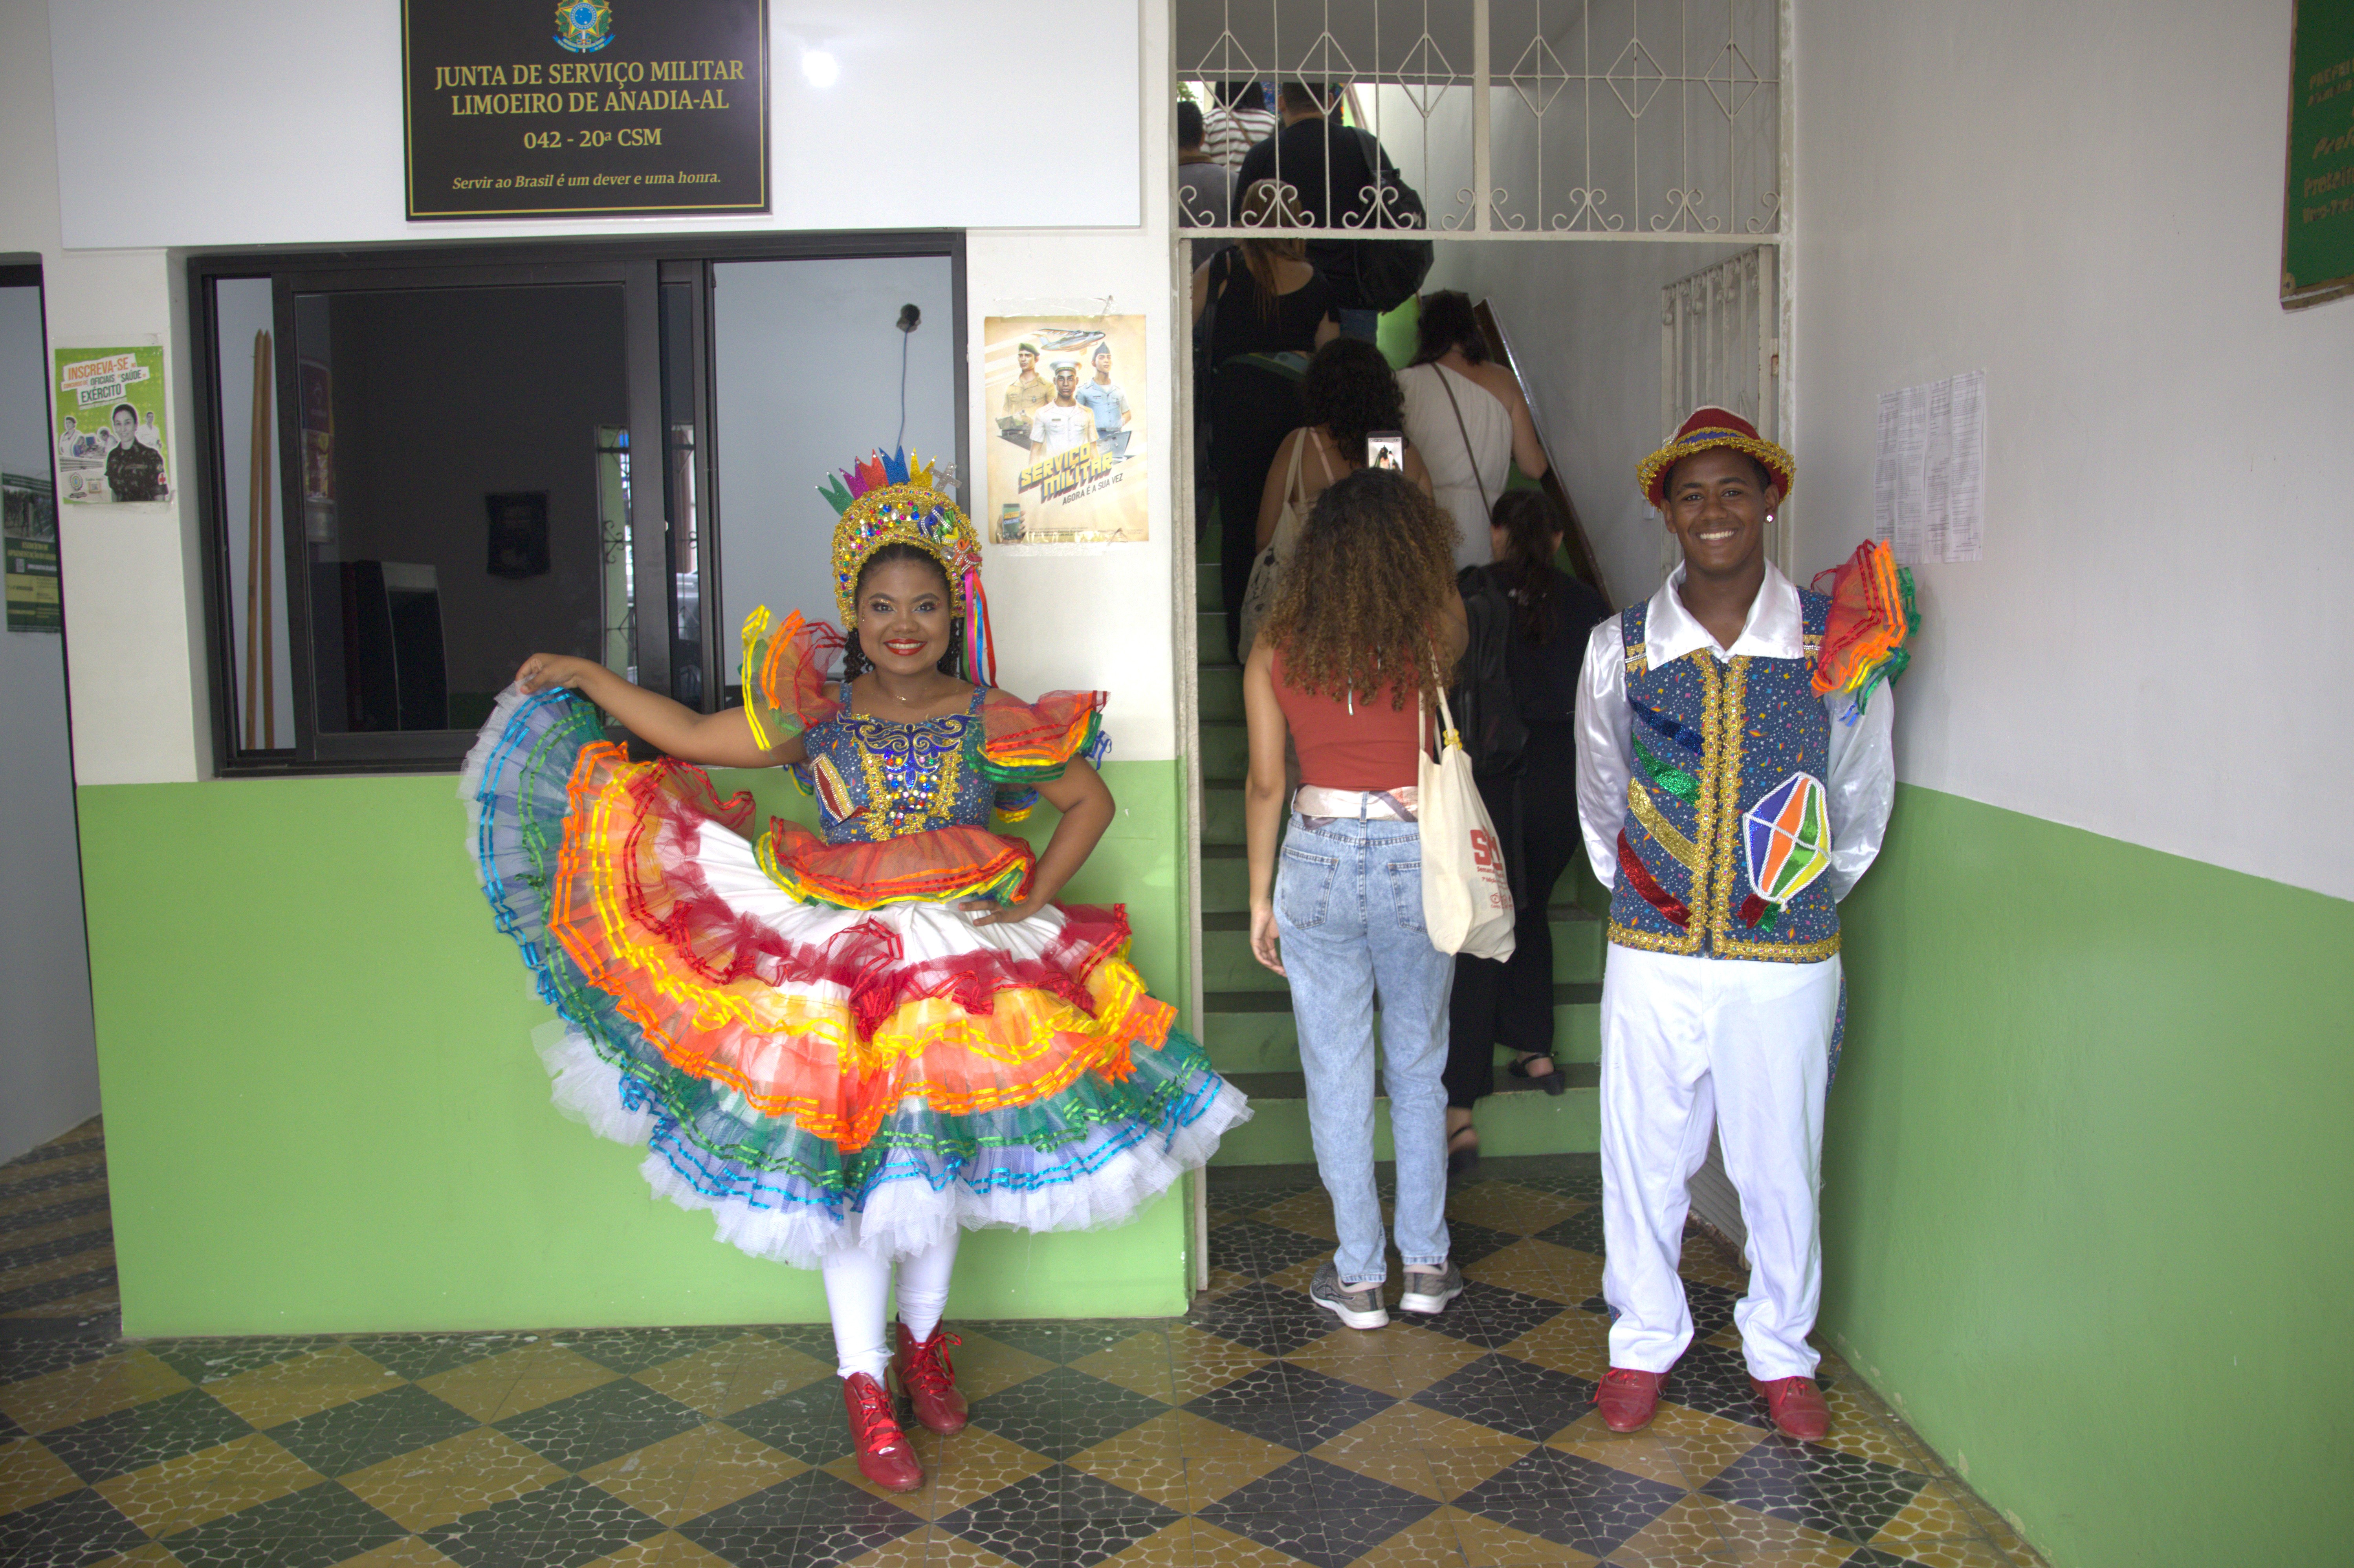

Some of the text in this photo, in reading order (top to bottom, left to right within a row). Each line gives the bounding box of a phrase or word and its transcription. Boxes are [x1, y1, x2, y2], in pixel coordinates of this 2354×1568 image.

[435, 60, 744, 90] JUNTA DE SERVIÇO MILITAR
[452, 89, 729, 115] LIMOEIRO DE ANADIA-AL
[524, 131, 561, 149] 042
[579, 130, 612, 147] 20ª
[618, 128, 662, 146] CSM
[453, 172, 720, 189] Servir ao Brasil é um dever e uma honra.
[68, 357, 128, 381] INSCREVA-SE
[90, 374, 115, 386] OFICIAIS
[121, 369, 141, 382] SAÚDE
[81, 383, 121, 403] EXÉRCITO
[1019, 442, 1090, 491] SERVIÇO
[1042, 452, 1113, 500] MILITAR
[1062, 490, 1085, 506] AGORA
[1087, 485, 1091, 495] É
[1098, 479, 1110, 490] SUA
[1112, 473, 1124, 484] VEZ
